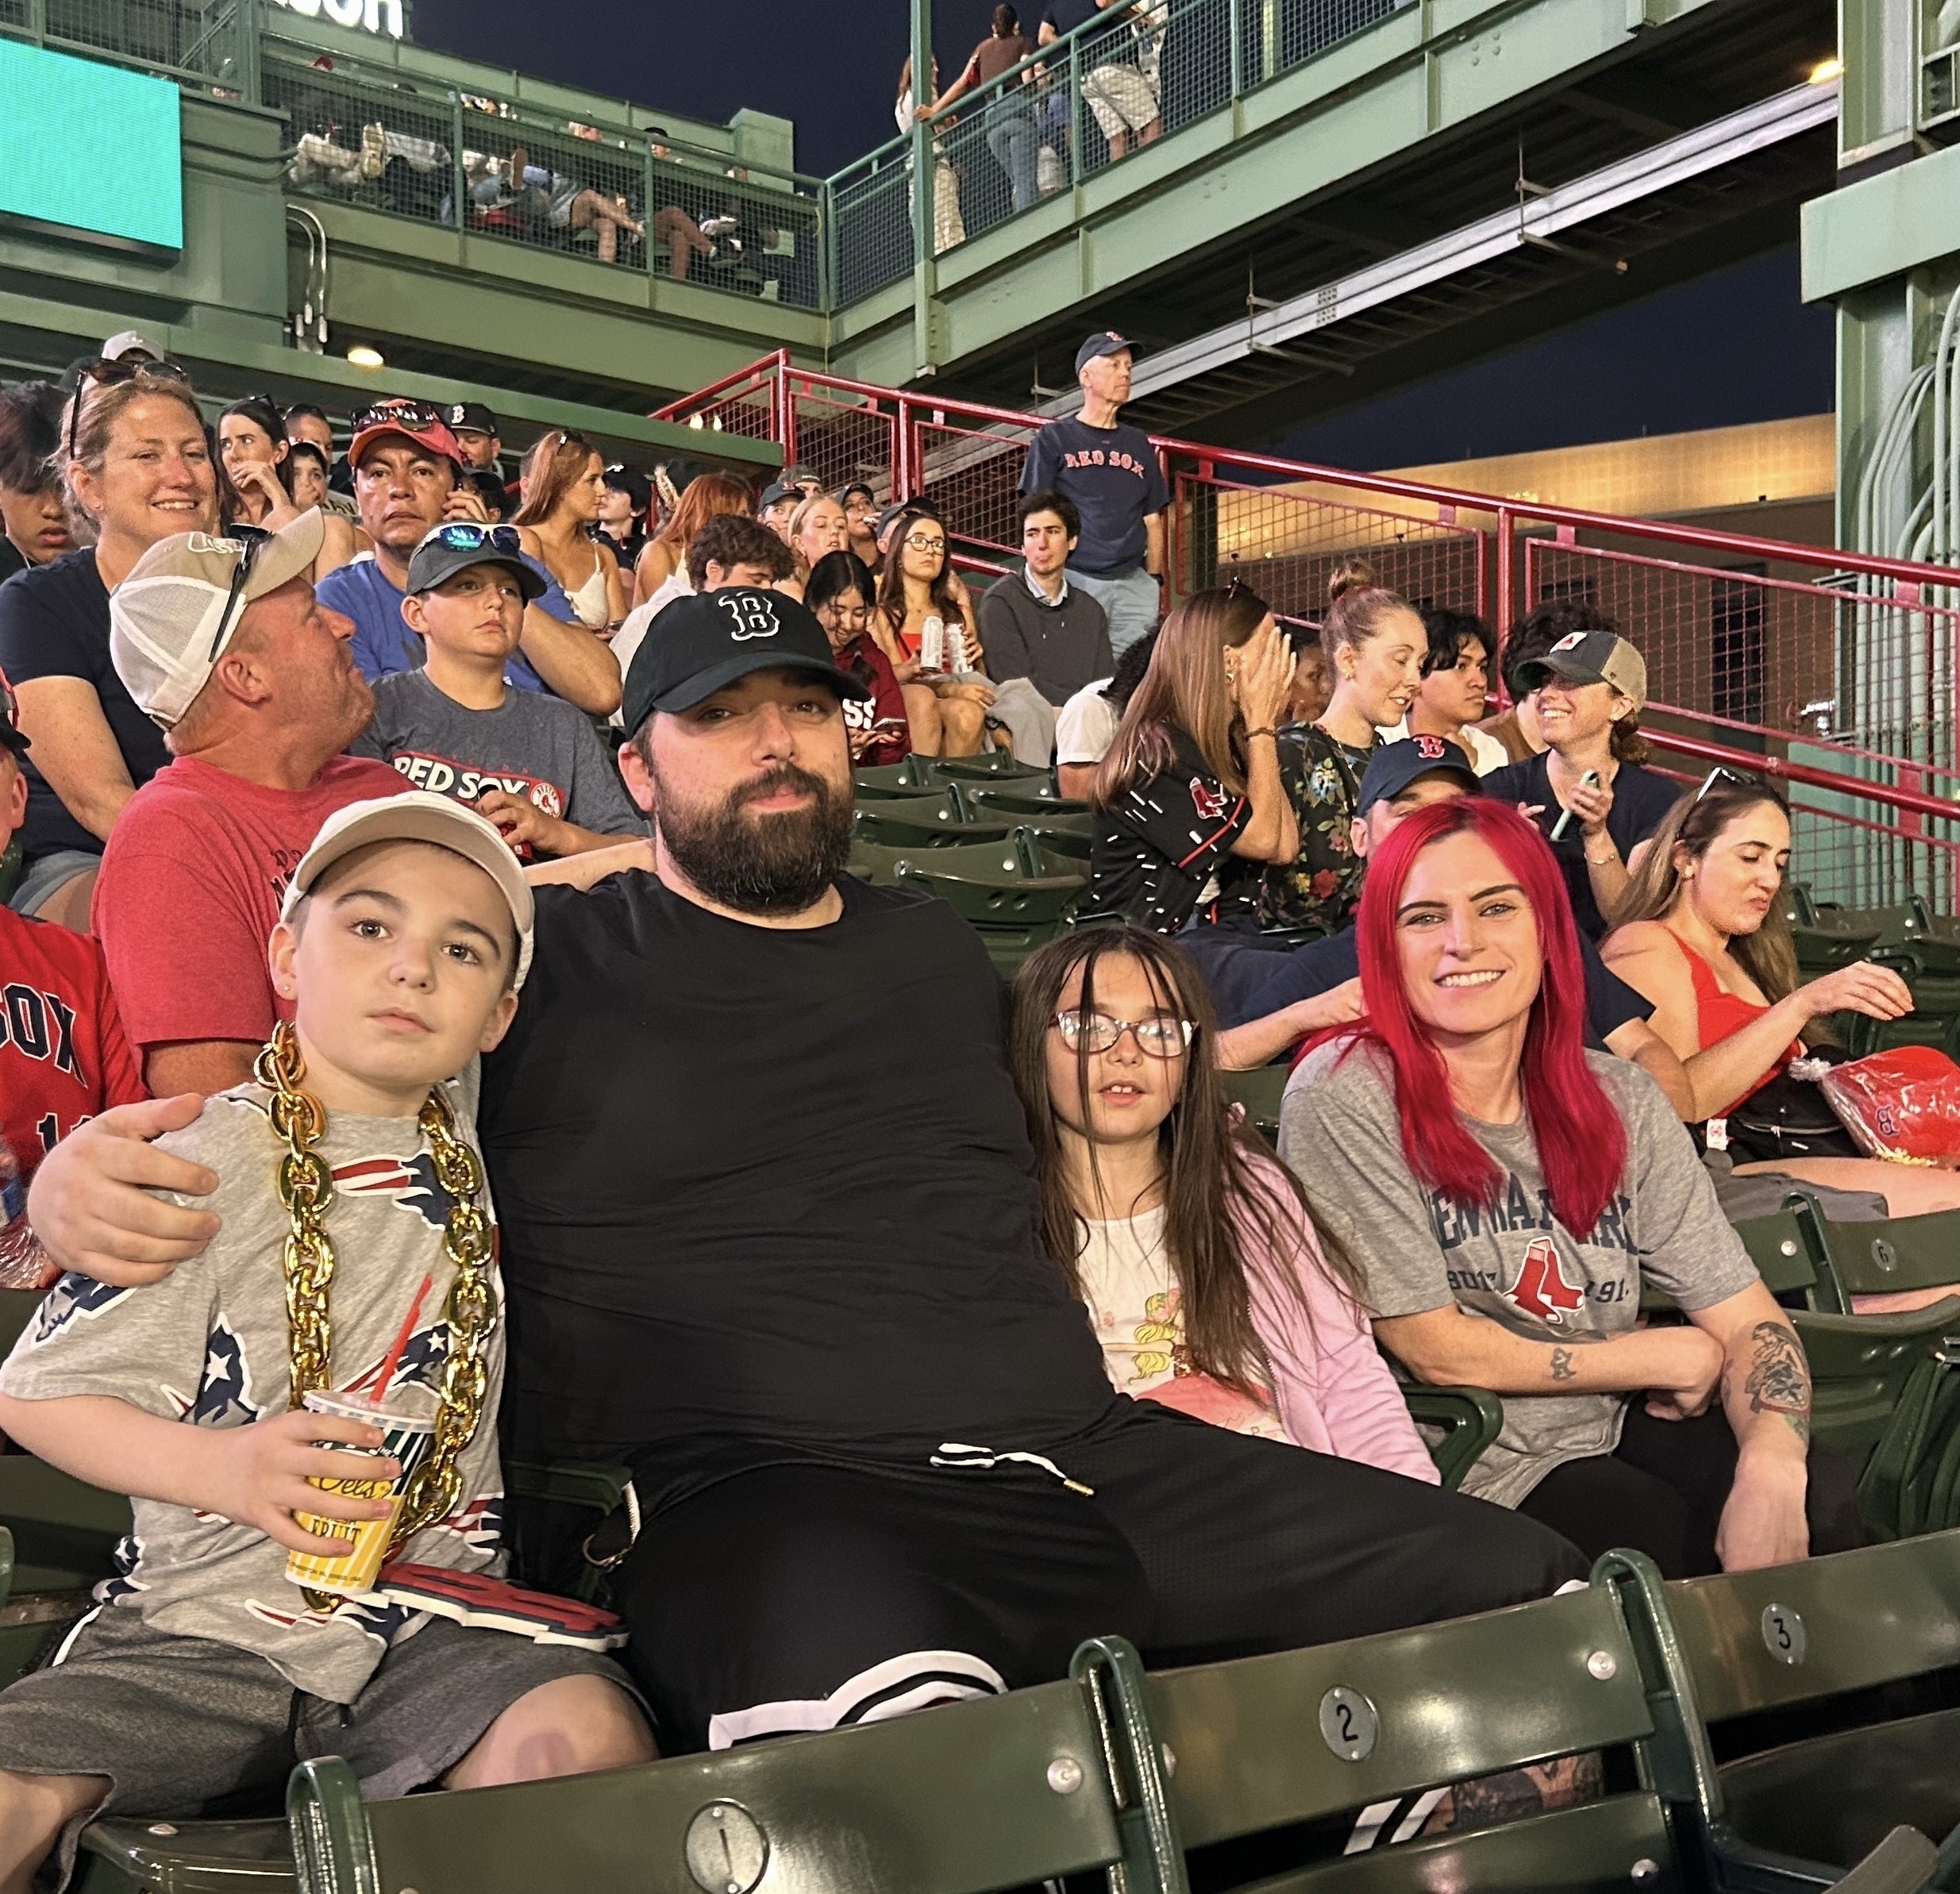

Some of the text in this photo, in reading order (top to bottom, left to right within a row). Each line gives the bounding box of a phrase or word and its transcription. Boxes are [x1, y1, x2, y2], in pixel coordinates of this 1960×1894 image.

[452, 405, 465, 424] B
[1065, 450, 1144, 479] RED SOX
[718, 591, 780, 641] B
[1413, 735, 1445, 759] B
[1878, 1245, 1889, 1263] 6
[1773, 1618, 1791, 1650] 3
[1336, 1703, 1359, 1742] 2
[719, 1828, 734, 1875] 1
